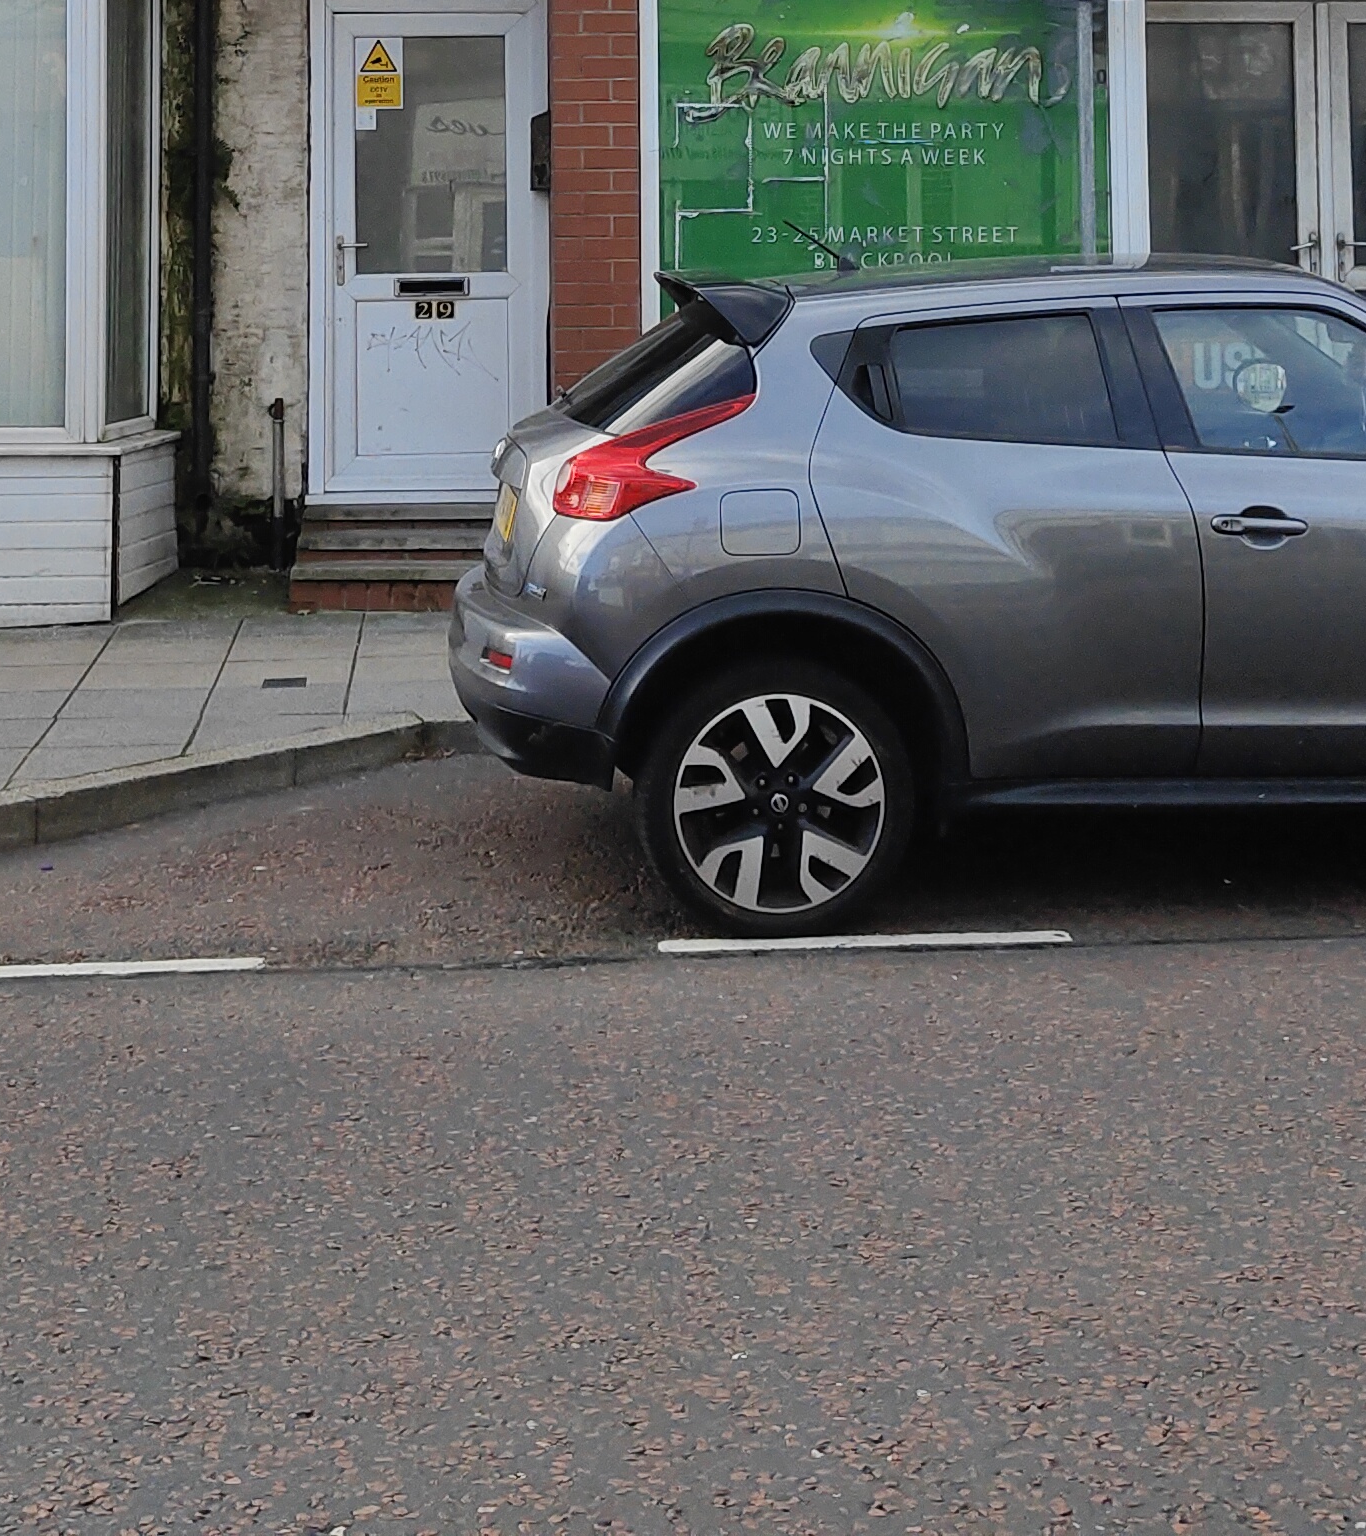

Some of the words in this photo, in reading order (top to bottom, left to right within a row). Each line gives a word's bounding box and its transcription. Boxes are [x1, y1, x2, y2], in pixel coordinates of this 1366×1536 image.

[362, 75, 395, 84] Caution
[763, 122, 797, 140] WE
[805, 122, 874, 140] MAKE
[877, 122, 922, 140] THE
[930, 122, 1005, 140] PARTY
[784, 148, 794, 165] 7
[801, 148, 892, 165] NIGHTS
[900, 148, 915, 165] A
[921, 148, 987, 165] WEEK
[827, 226, 924, 244] MARKET
[931, 226, 1019, 244] STREET
[417, 302, 454, 319] 29
